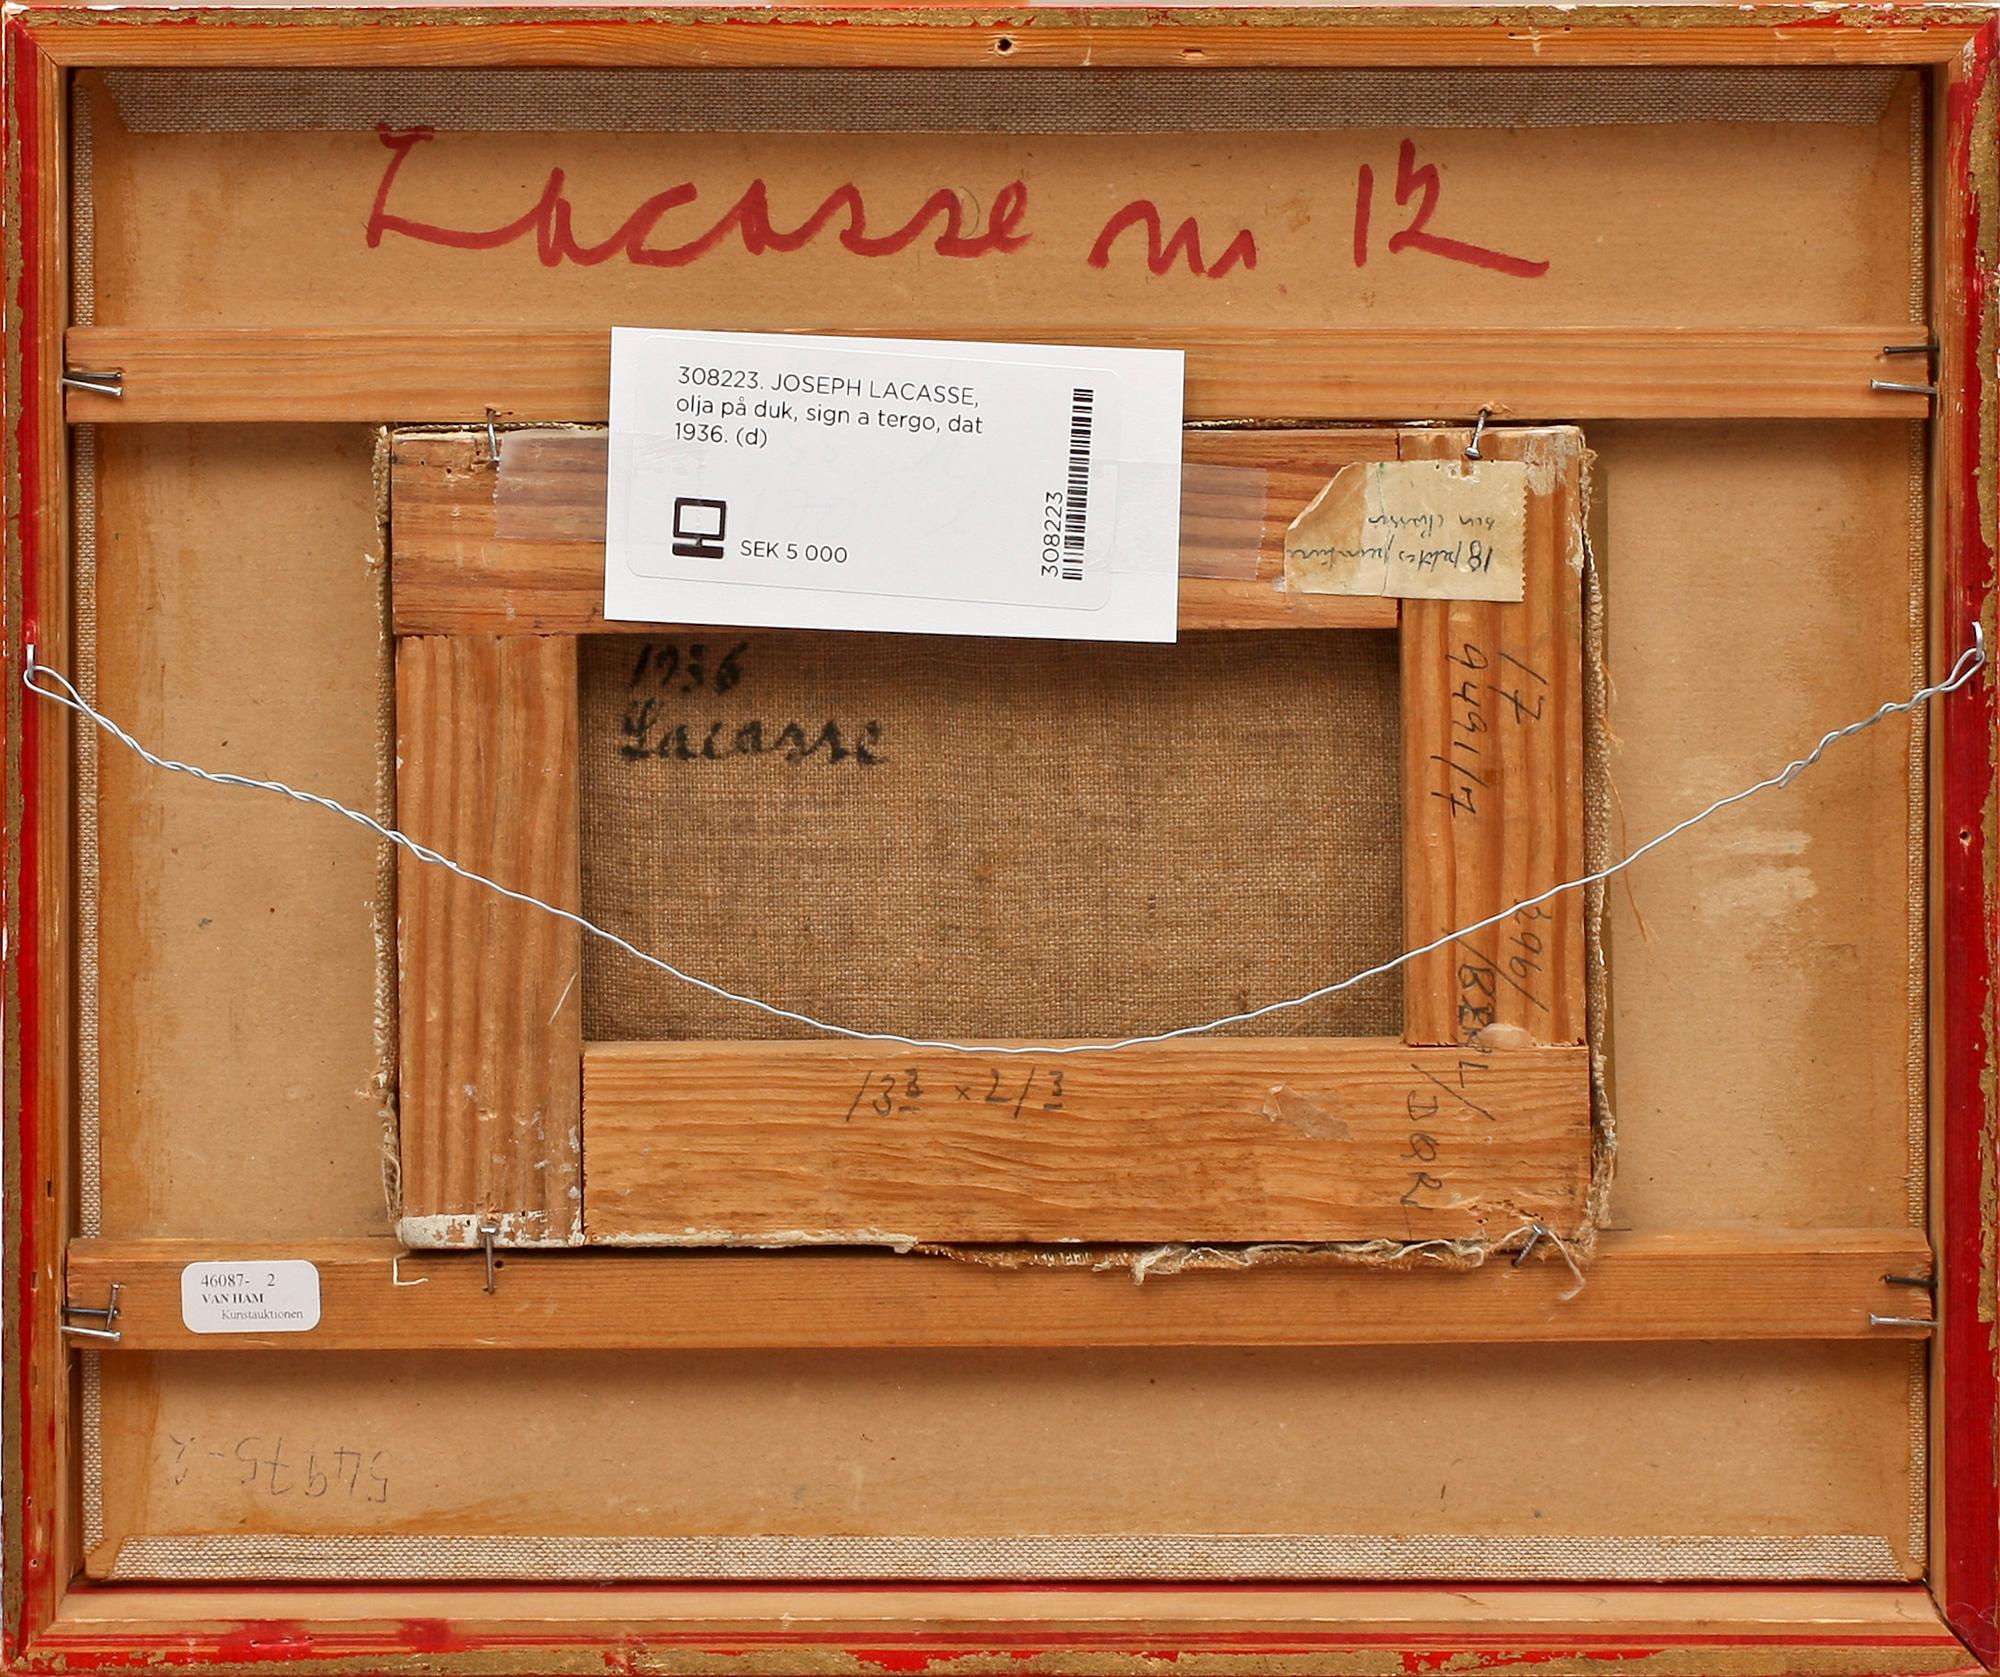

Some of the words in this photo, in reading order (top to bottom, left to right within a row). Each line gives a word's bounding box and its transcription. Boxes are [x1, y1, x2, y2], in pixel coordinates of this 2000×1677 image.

[678, 366, 764, 391] 308223.
[770, 373, 861, 397] JOSEPH
[870, 382, 979, 407] LACASSE,
[675, 395, 714, 417] olja
[720, 395, 747, 419] på
[754, 398, 798, 422] duk,
[806, 403, 850, 428] sign
[857, 411, 869, 426] a
[878, 409, 941, 434] tergo,
[948, 415, 983, 434] dat
[675, 422, 728, 443] 1936.
[736, 426, 768, 449] (d)
[1041, 490, 1064, 577] 308223
[740, 540, 779, 558] SEK
[630, 641, 748, 696] 1936
[267, 1273, 276, 1288] 2
[202, 1293, 230, 1304] VAN
[233, 1293, 264, 1303] HAM
[221, 1308, 304, 1321] Kunstauktionen
